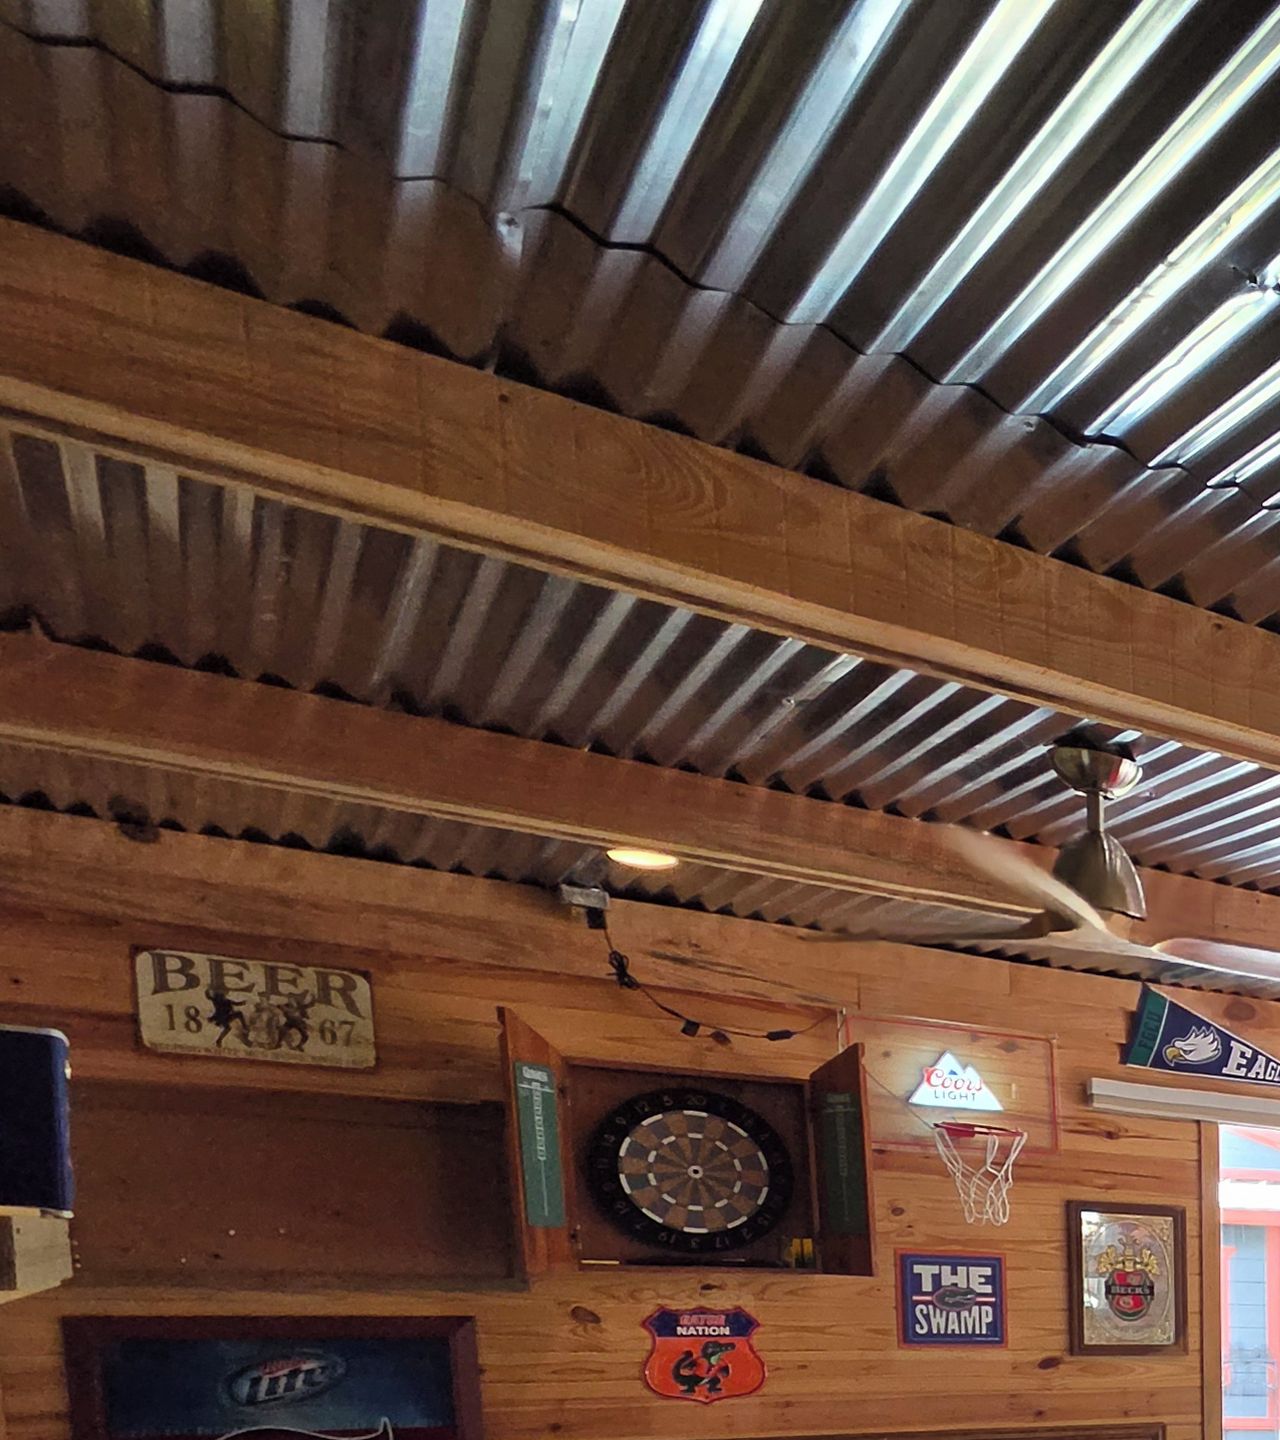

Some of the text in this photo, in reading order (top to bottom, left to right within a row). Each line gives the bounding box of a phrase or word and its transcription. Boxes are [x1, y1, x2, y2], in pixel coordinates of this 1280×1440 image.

[150, 951, 366, 1020] BEER
[163, 1002, 356, 1048] 18 67
[922, 1066, 983, 1092] Coors
[934, 1088, 977, 1102] LIGHT
[913, 1264, 993, 1293] THE
[676, 1325, 730, 1336] NATION
[914, 1303, 993, 1335] SWAMP
